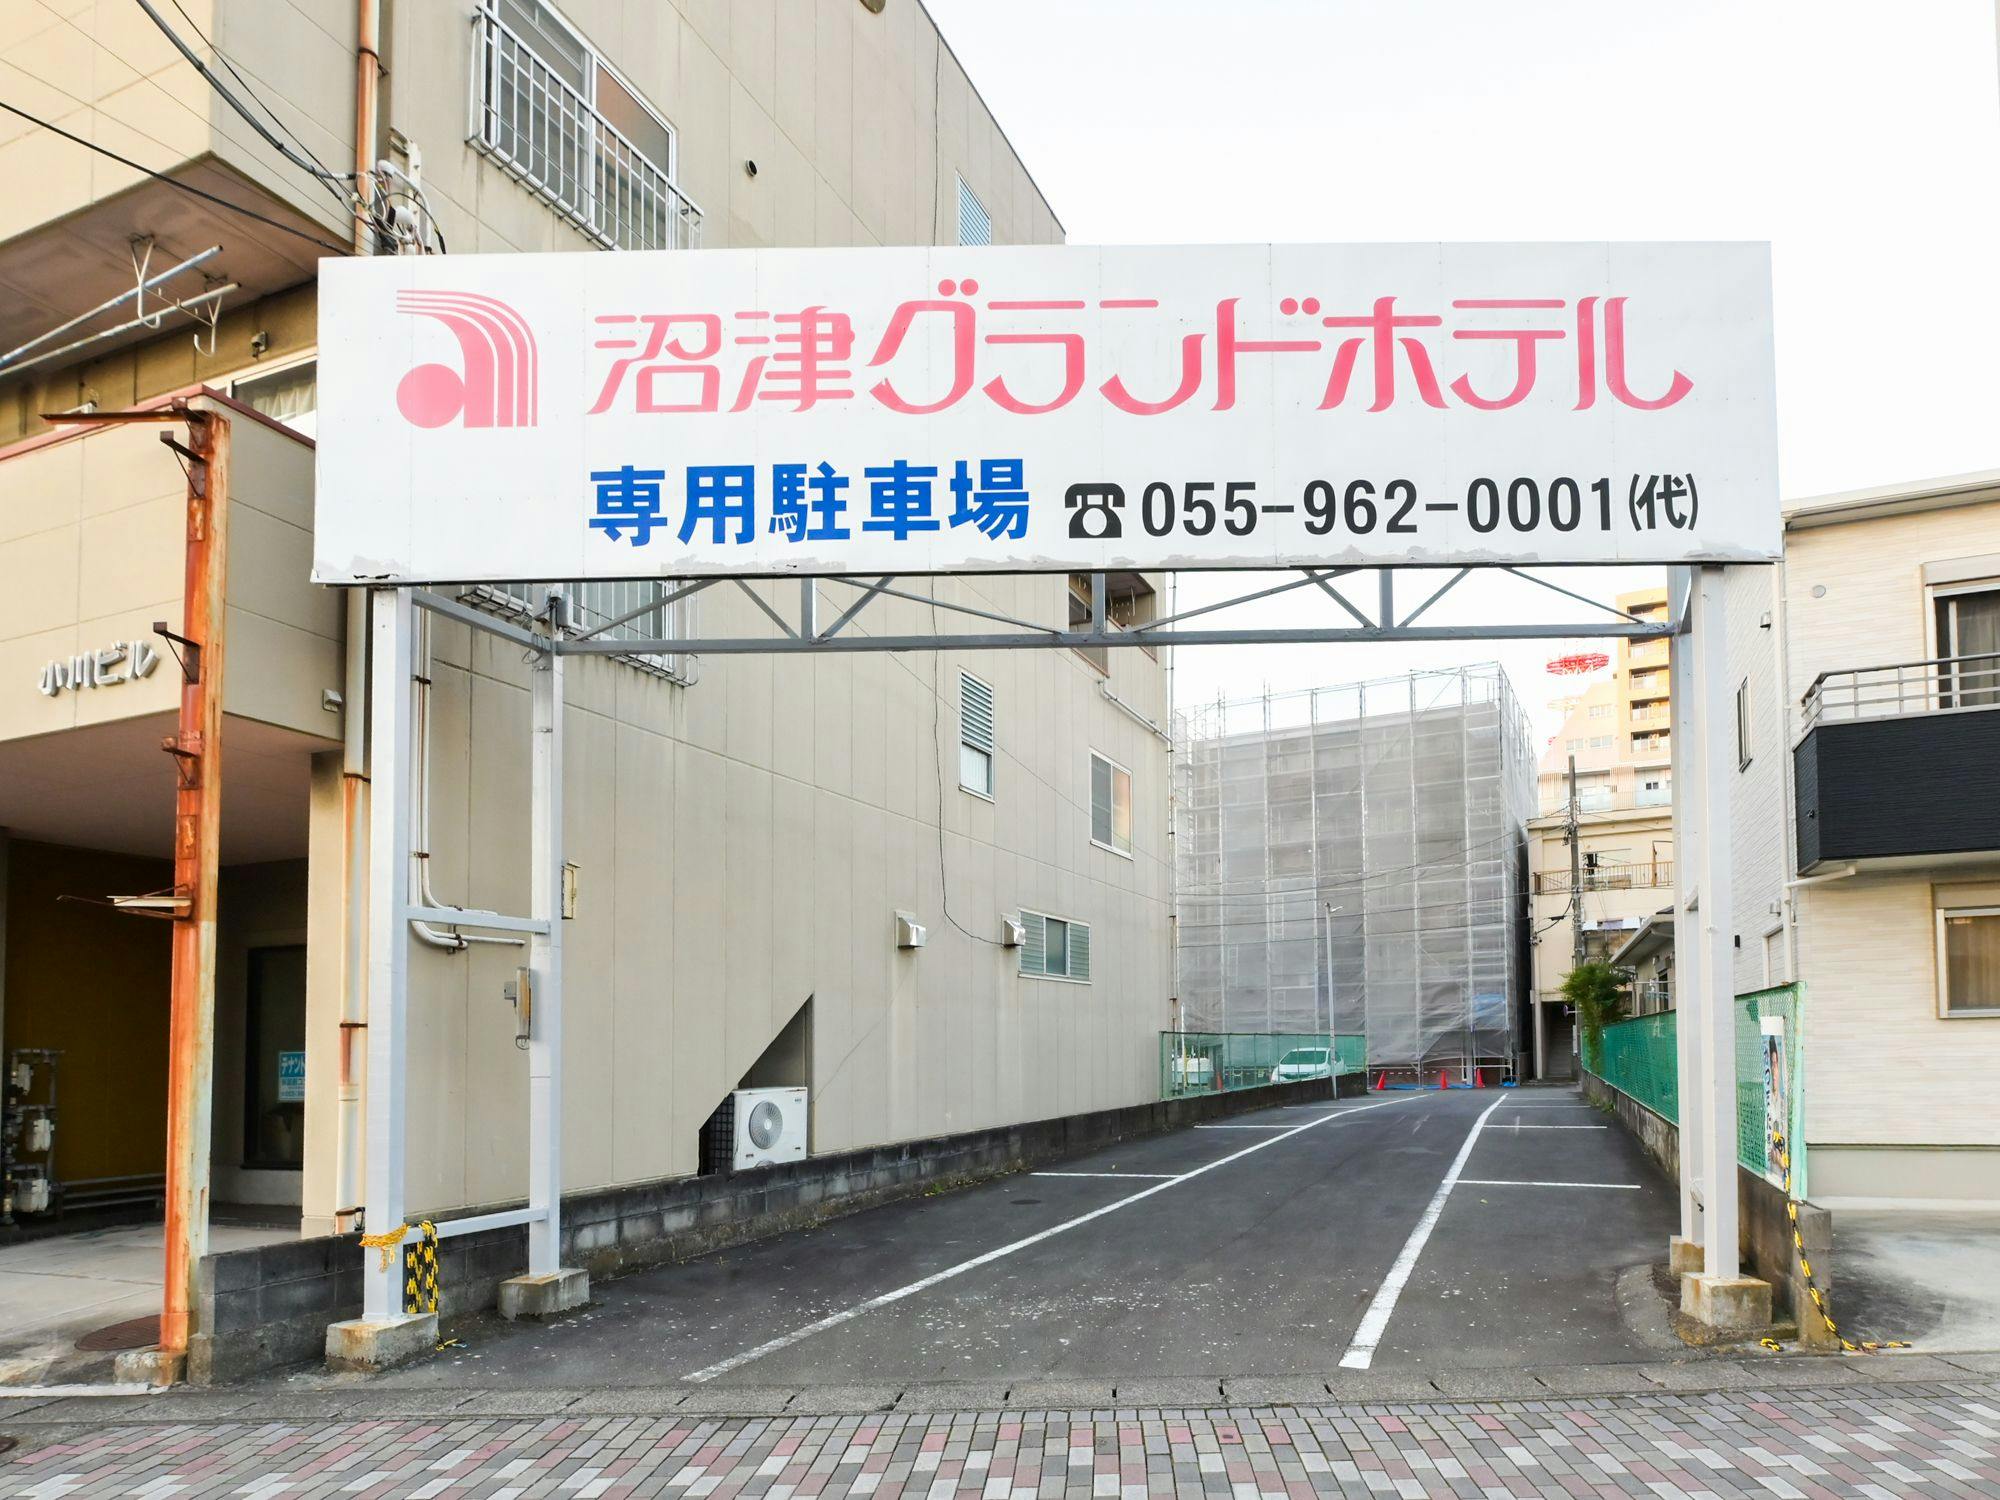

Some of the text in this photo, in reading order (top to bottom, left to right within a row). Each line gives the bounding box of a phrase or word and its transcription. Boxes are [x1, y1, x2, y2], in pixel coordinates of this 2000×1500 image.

[586, 278, 1694, 416] 沼津グランドホテル
[588, 457, 1030, 547] 専用駐車場
[38, 640, 159, 696] 小川ビル
